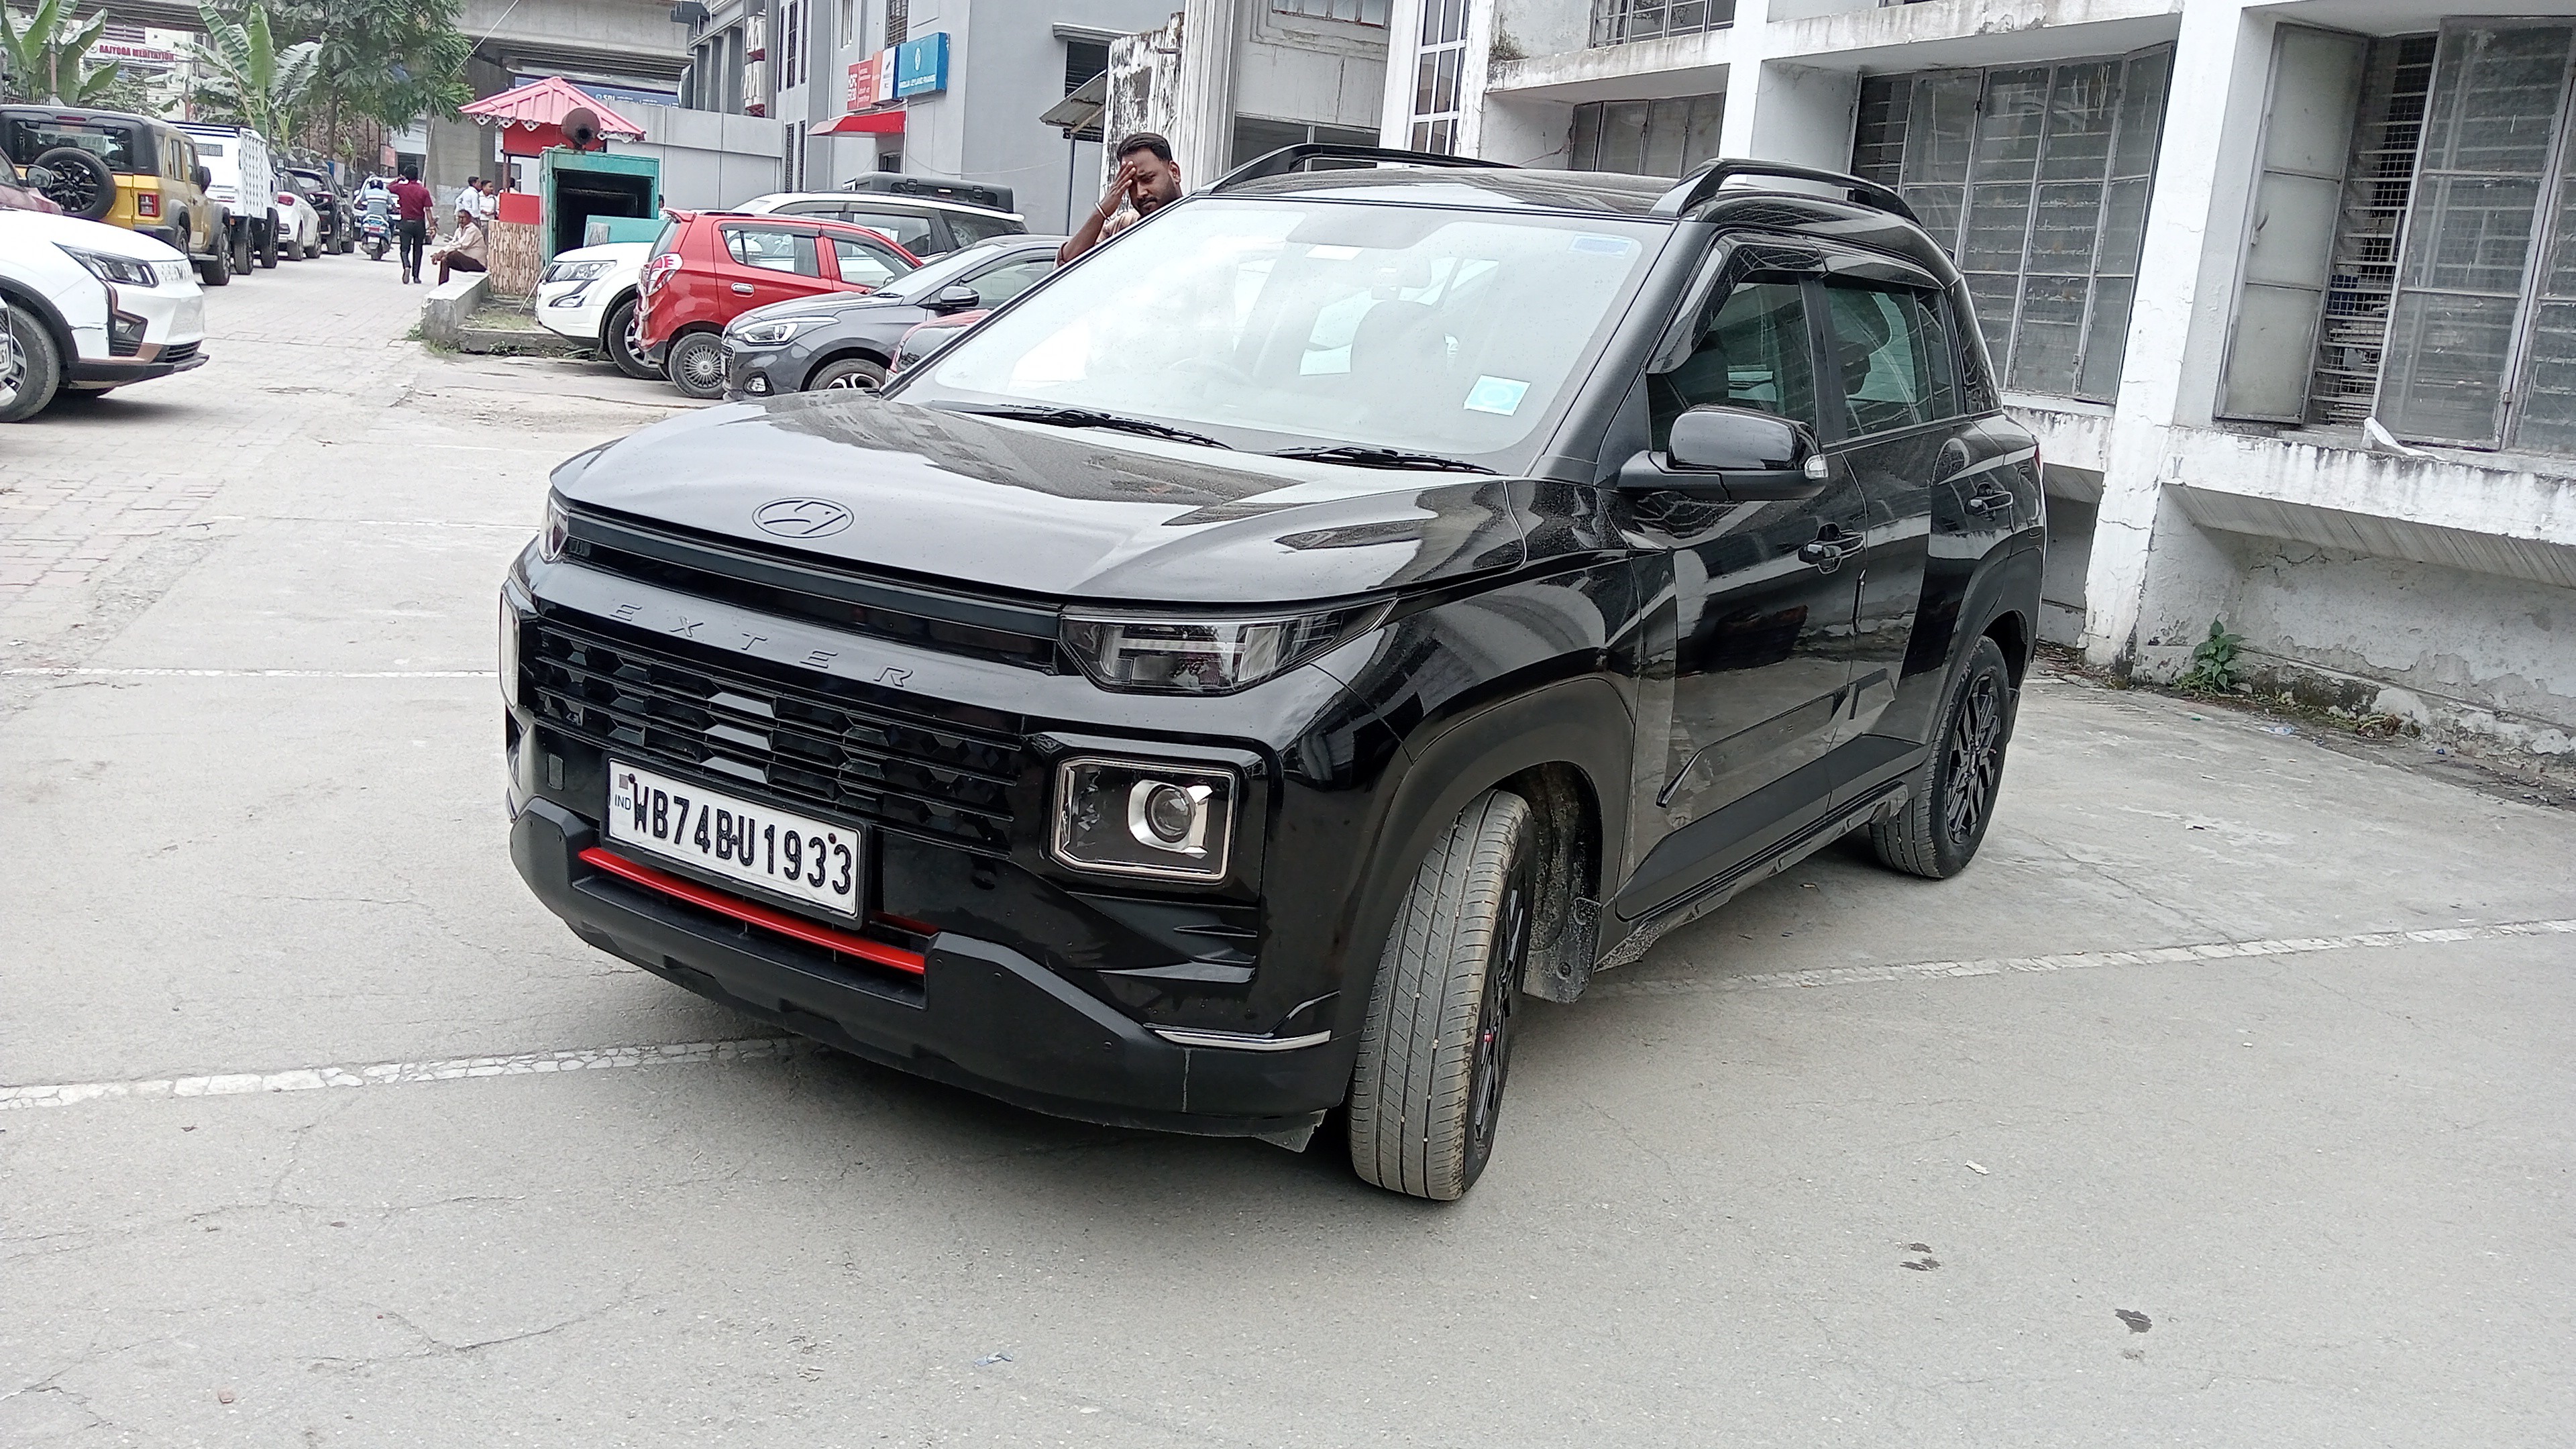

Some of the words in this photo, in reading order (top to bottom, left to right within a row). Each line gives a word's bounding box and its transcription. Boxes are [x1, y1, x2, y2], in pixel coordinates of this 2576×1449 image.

[99, 44, 131, 56] RAJYOGA
[608, 603, 914, 688] EXTER
[614, 794, 632, 811] IND
[633, 782, 853, 896] WB74BU1933
